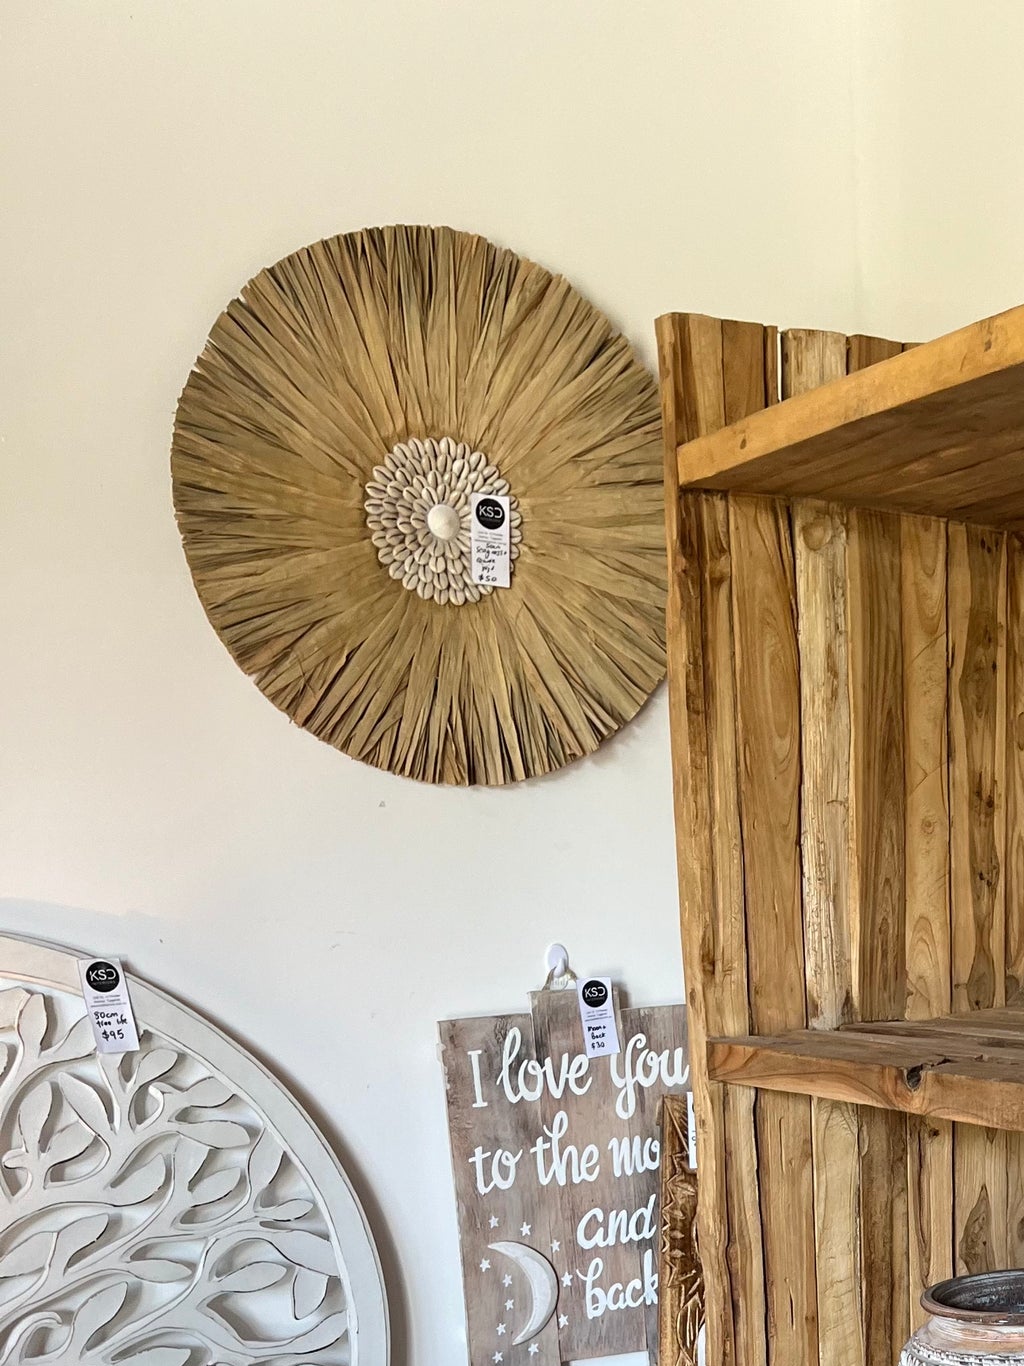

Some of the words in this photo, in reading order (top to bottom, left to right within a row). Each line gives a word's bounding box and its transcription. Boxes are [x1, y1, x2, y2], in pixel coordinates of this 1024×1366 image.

[478, 574, 497, 582] $50
[102, 1029, 125, 1042] $95
[467, 1050, 488, 1108] I
[496, 1027, 592, 1103] love
[469, 1146, 523, 1195] to
[530, 1110, 600, 1186] the
[608, 1135, 660, 1177] mo
[577, 1194, 657, 1250] and
[576, 1249, 658, 1320] back
